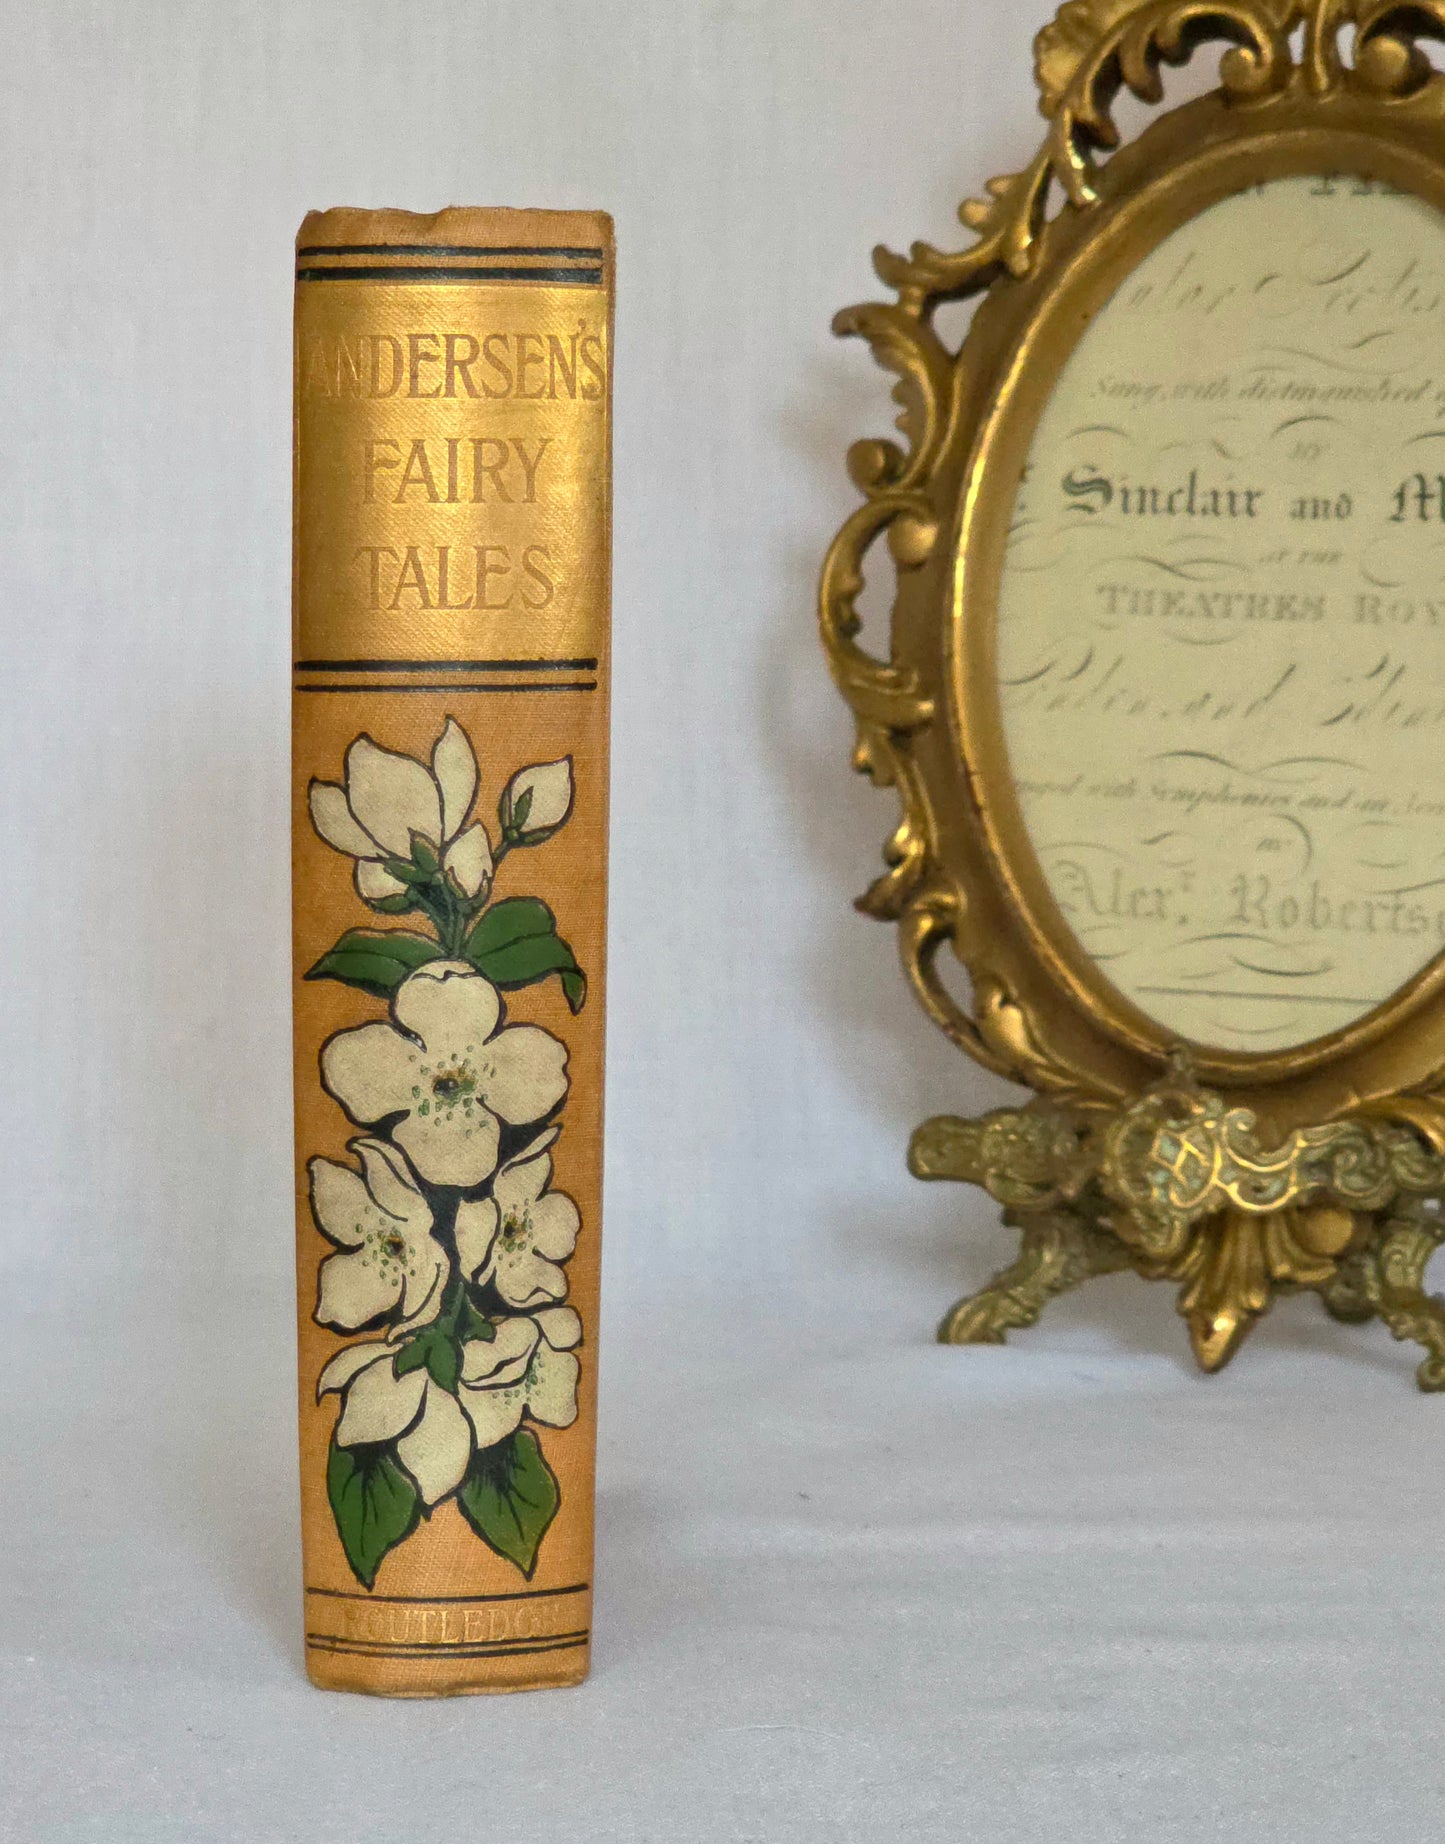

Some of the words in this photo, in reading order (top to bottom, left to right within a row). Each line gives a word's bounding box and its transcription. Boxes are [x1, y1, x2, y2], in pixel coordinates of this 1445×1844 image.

[304, 319, 602, 401] ANDERSEN'S
[362, 438, 553, 503] FAIRY
[1061, 464, 1263, 516] Sinclair
[354, 545, 555, 610] TALES
